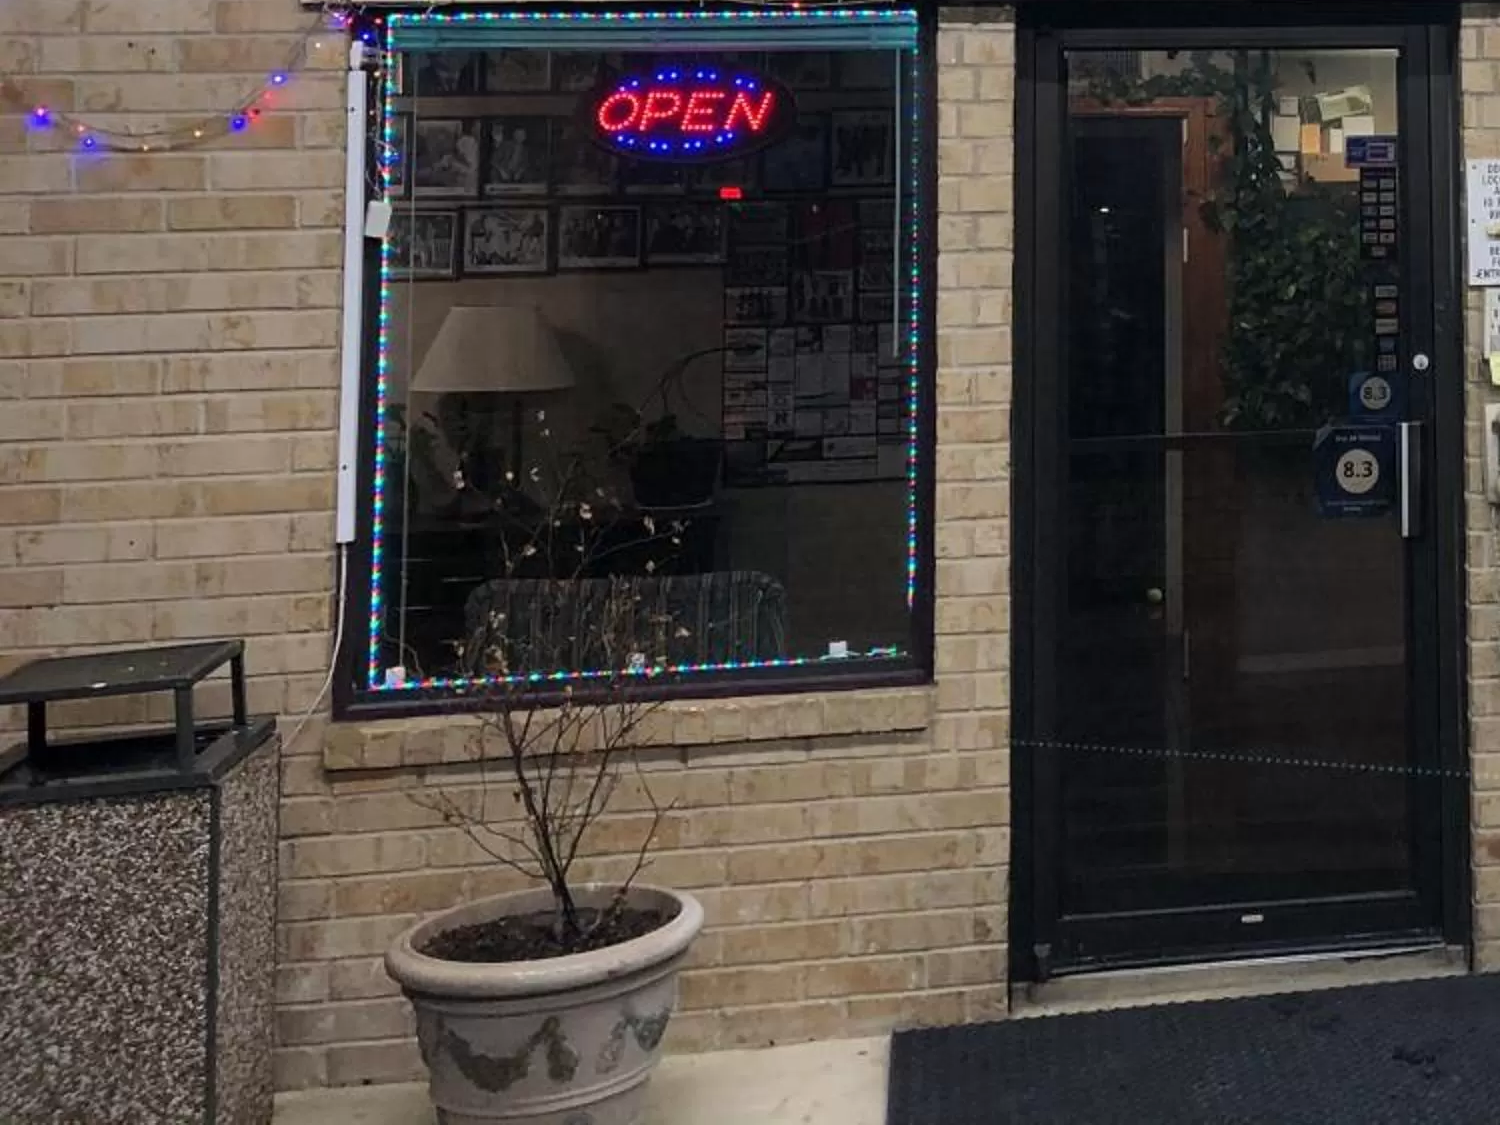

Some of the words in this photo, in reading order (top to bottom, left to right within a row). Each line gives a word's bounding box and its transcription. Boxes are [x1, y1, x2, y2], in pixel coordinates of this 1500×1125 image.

[598, 92, 773, 131] OPEN
[1363, 386, 1388, 401] 8.3
[1343, 460, 1374, 479] 8.3
